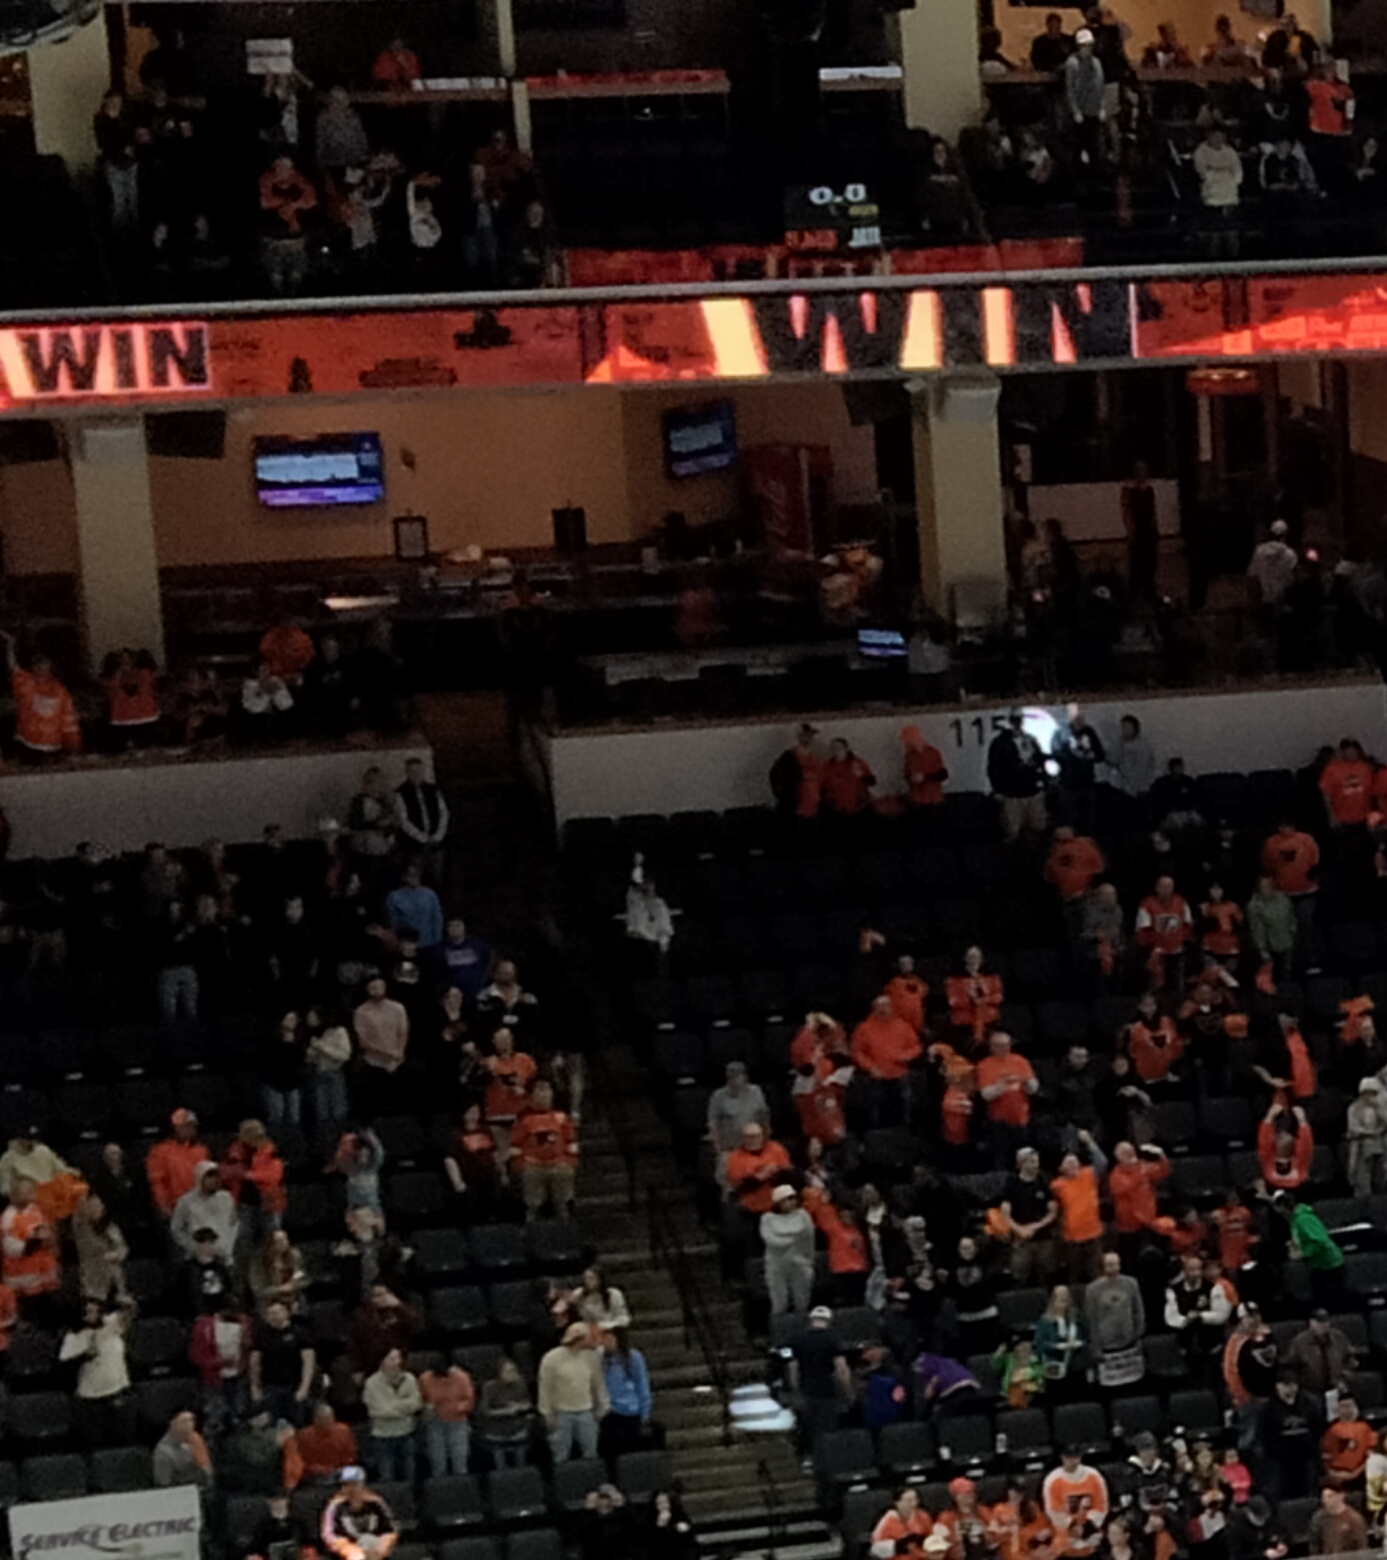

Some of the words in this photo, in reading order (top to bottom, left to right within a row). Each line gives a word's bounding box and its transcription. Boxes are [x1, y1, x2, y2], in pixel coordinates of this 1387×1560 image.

[20, 322, 208, 392] WIN
[20, 1527, 100, 1552] SERVICE
[109, 1516, 196, 1543] ELECTRIC
